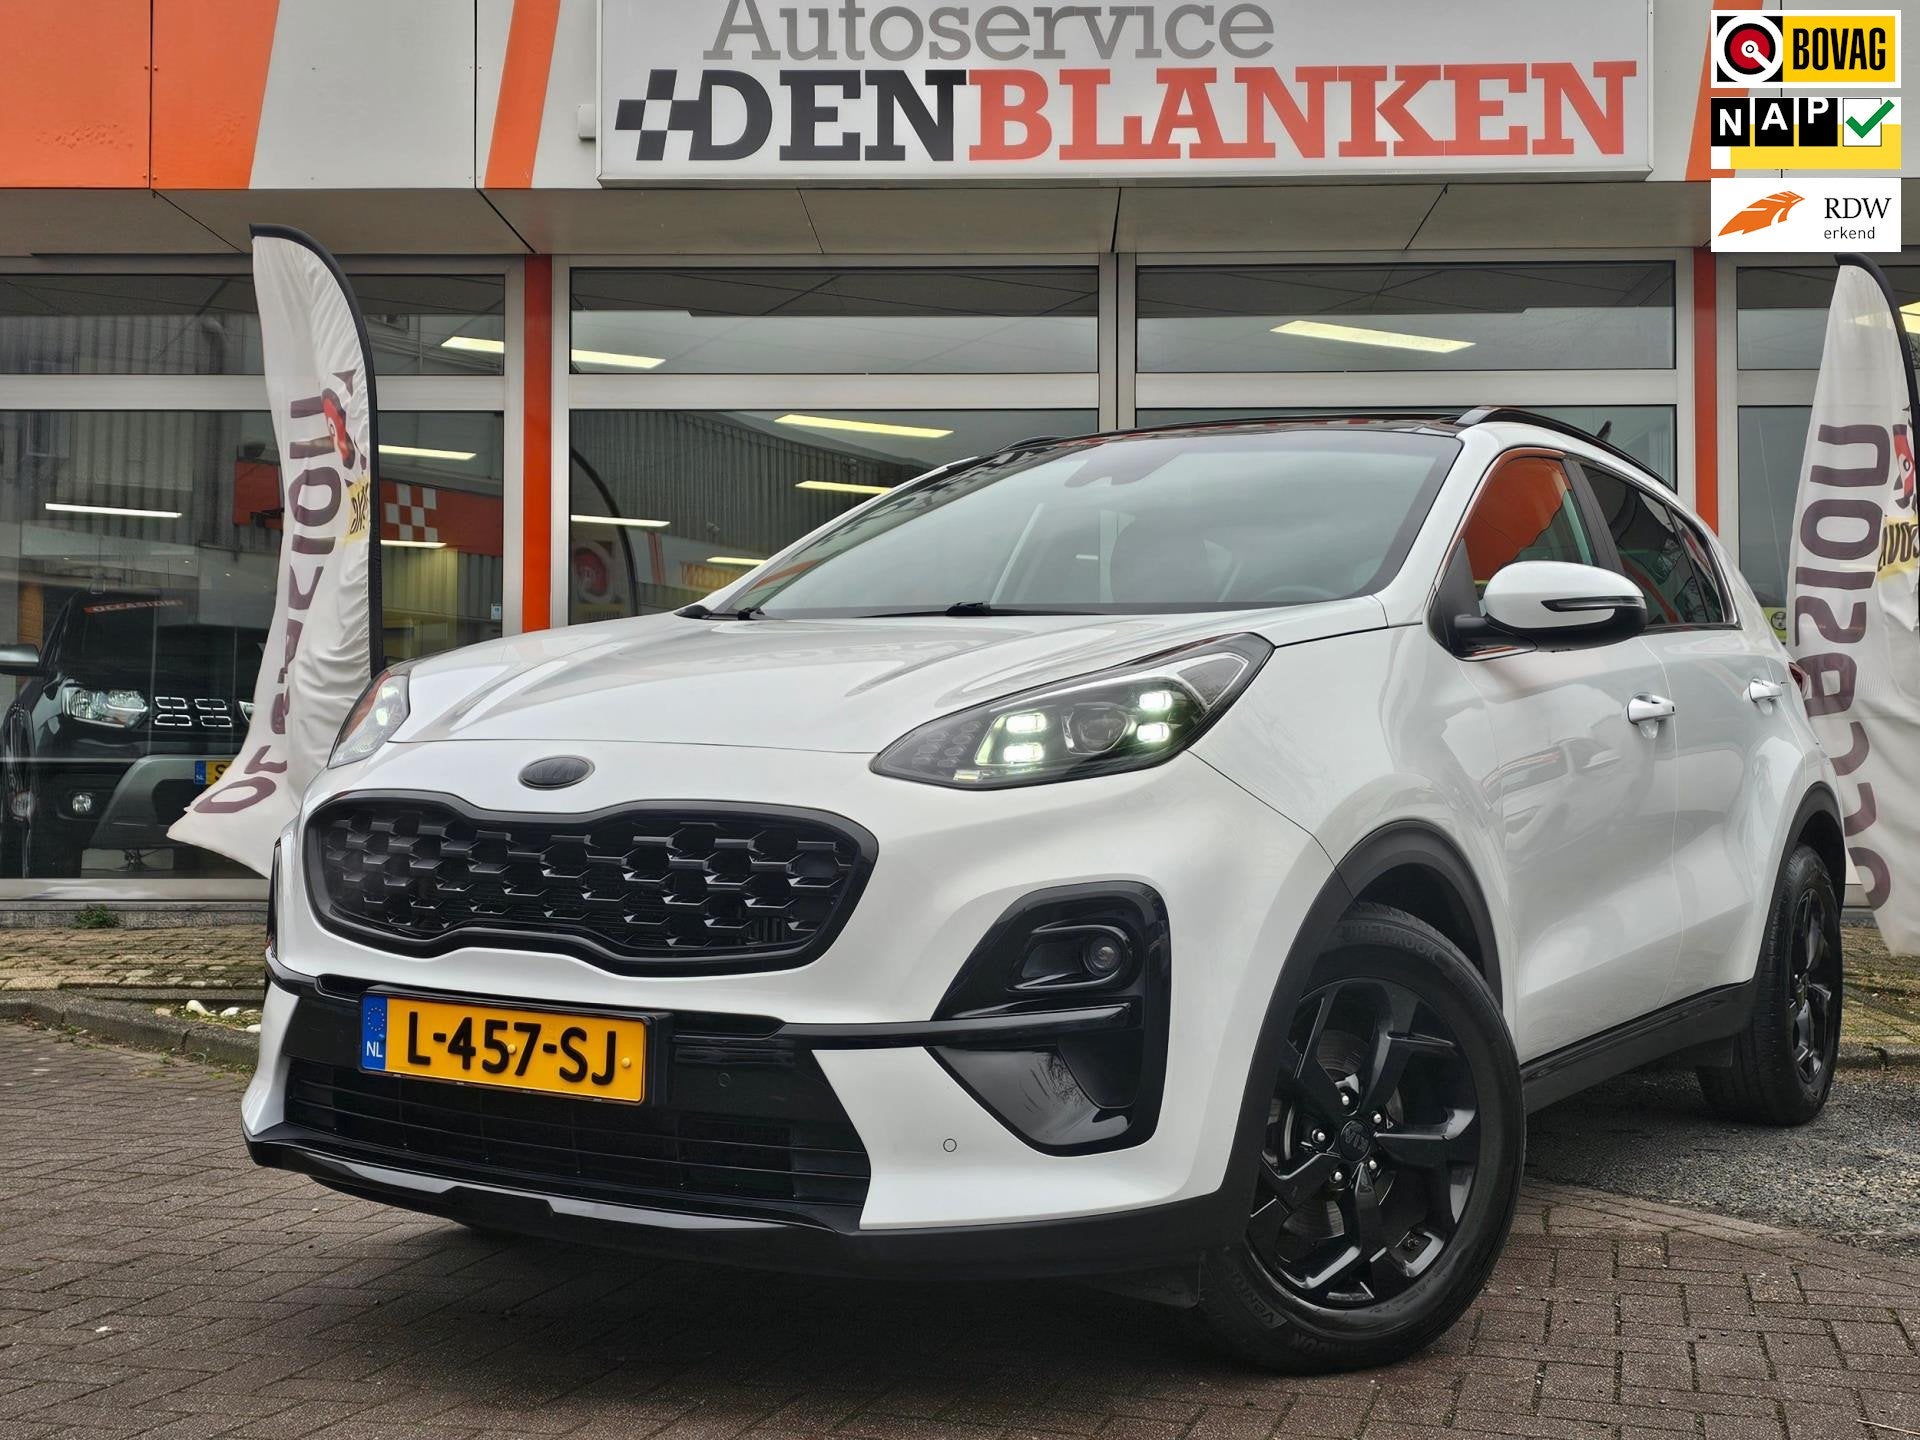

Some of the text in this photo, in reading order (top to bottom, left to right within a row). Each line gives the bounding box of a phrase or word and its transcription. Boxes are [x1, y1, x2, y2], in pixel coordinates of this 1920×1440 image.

[703, 0, 1274, 61] Autoservice
[366, 1041, 383, 1058] NL
[408, 1011, 617, 1085] L-457-SJ
